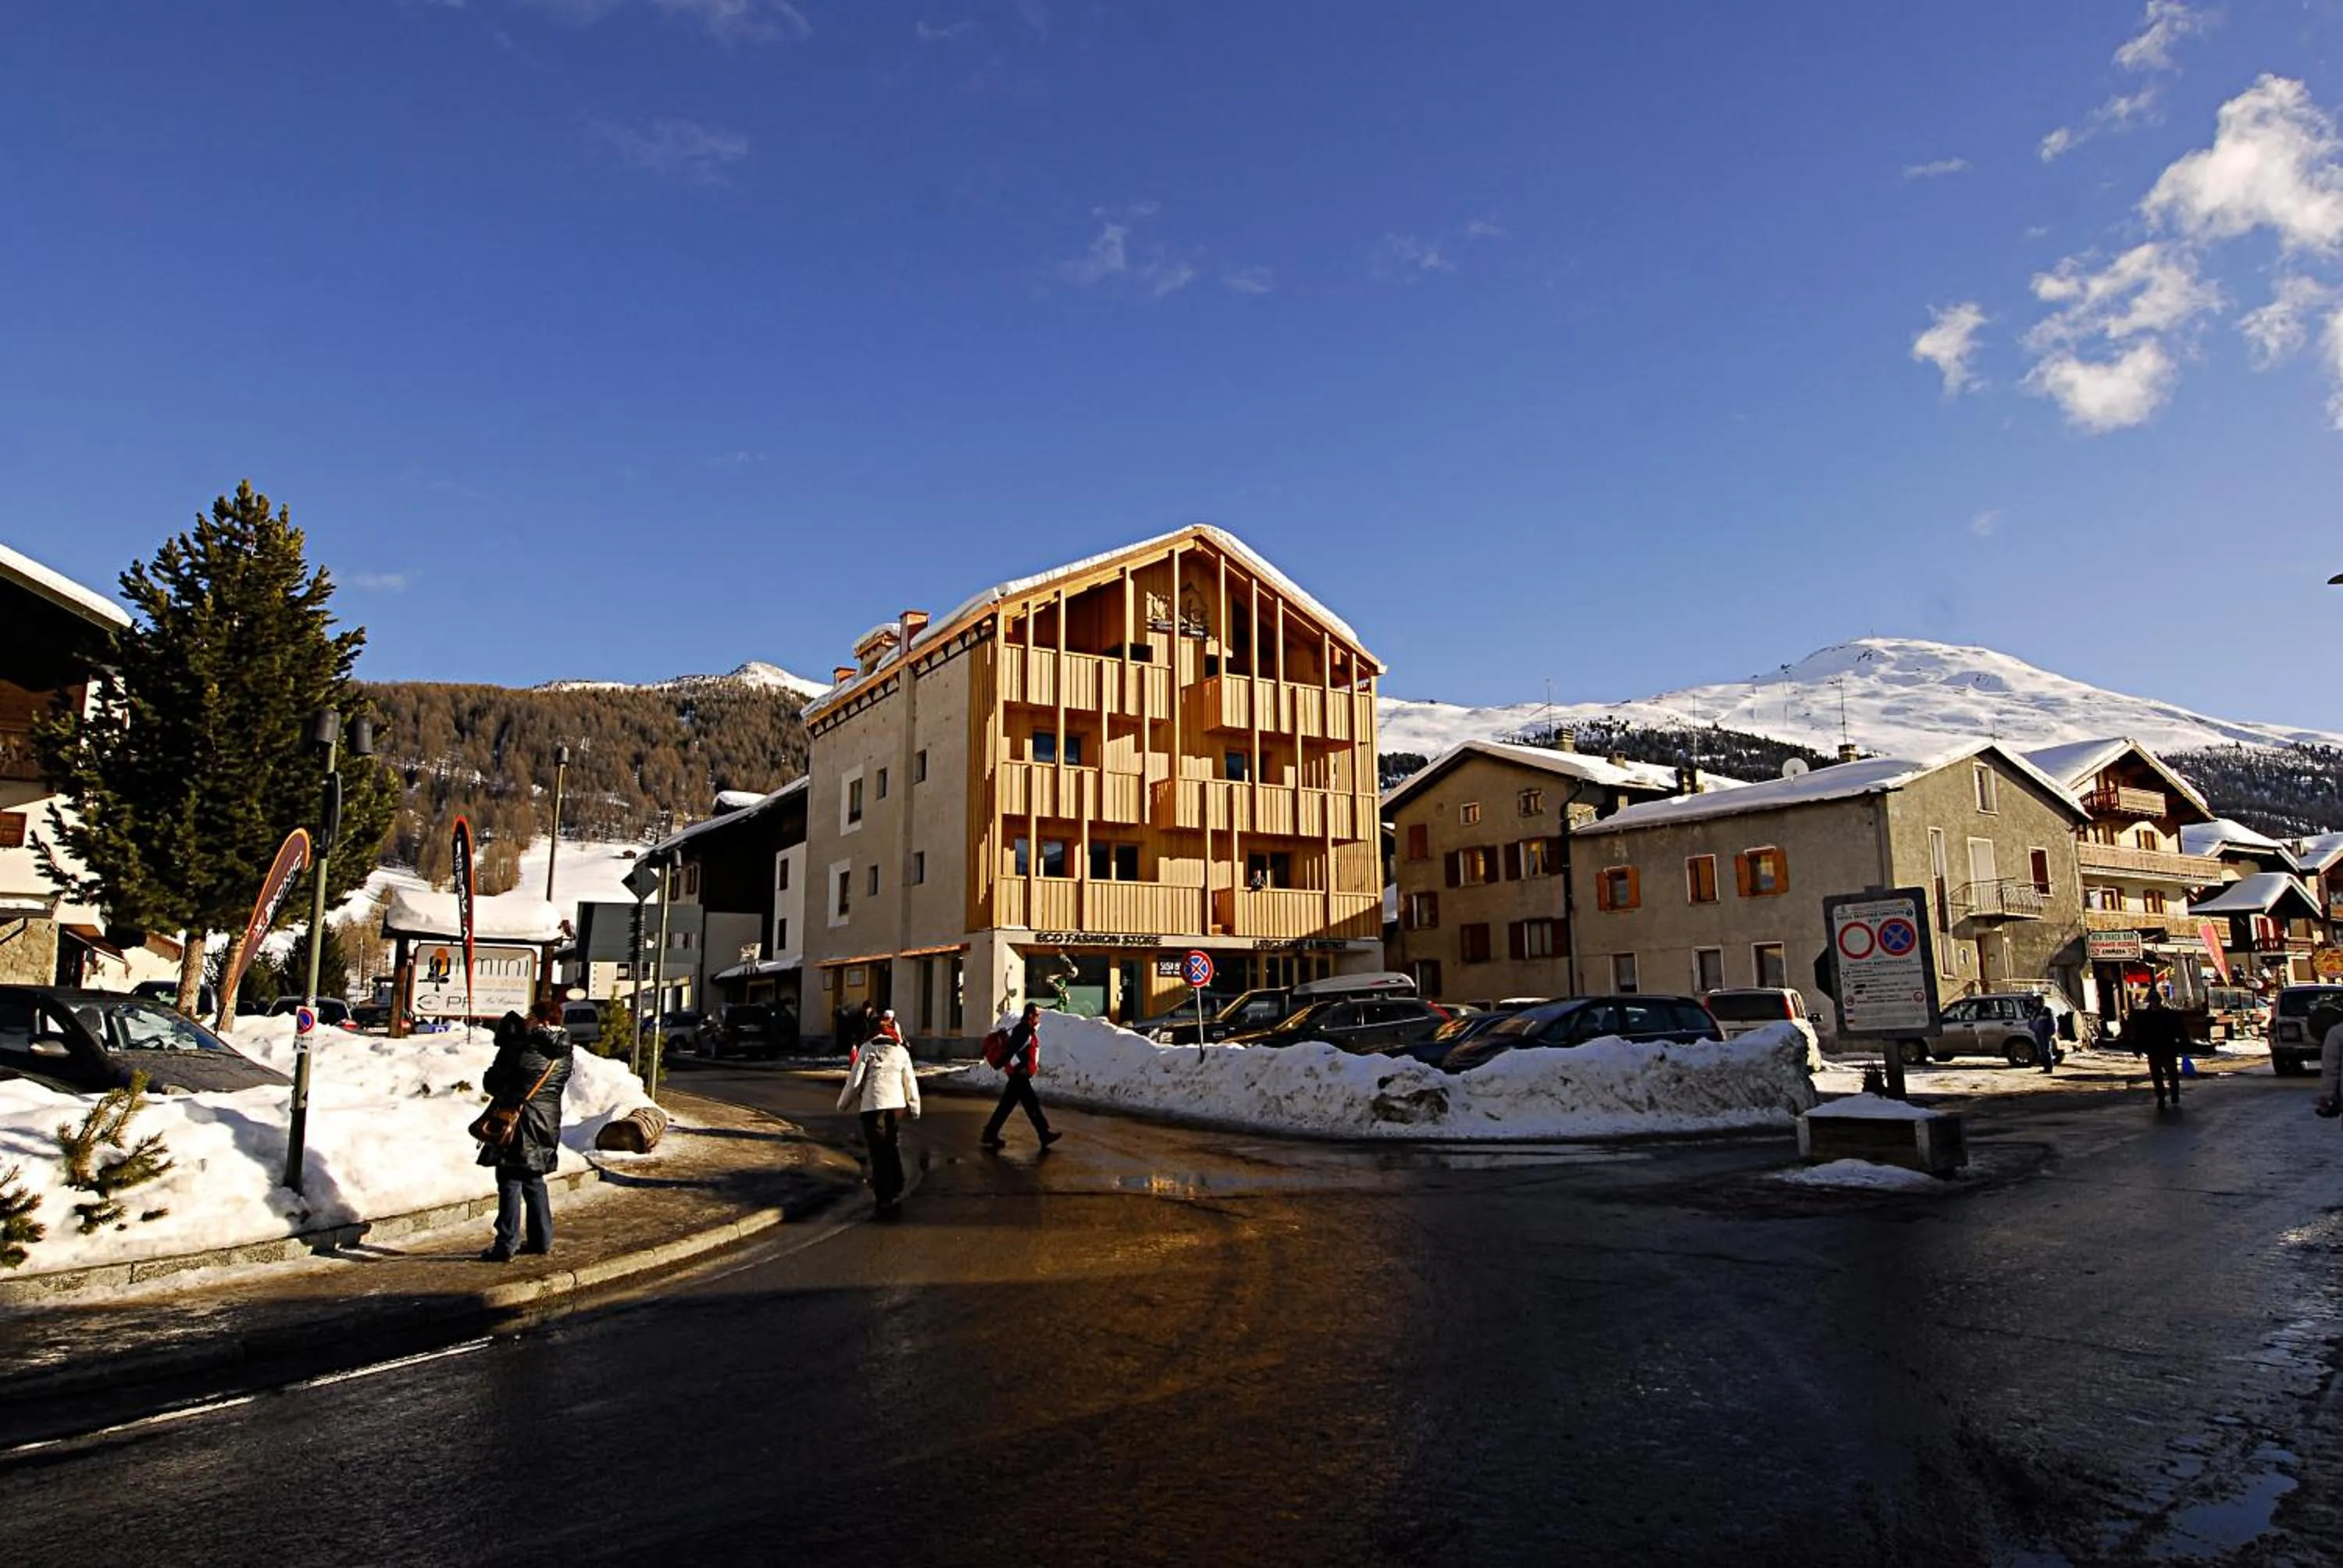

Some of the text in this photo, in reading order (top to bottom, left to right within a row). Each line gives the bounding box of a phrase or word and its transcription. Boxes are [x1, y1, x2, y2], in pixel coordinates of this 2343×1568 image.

[1034, 933, 1162, 946] ECO FASHION STORE
